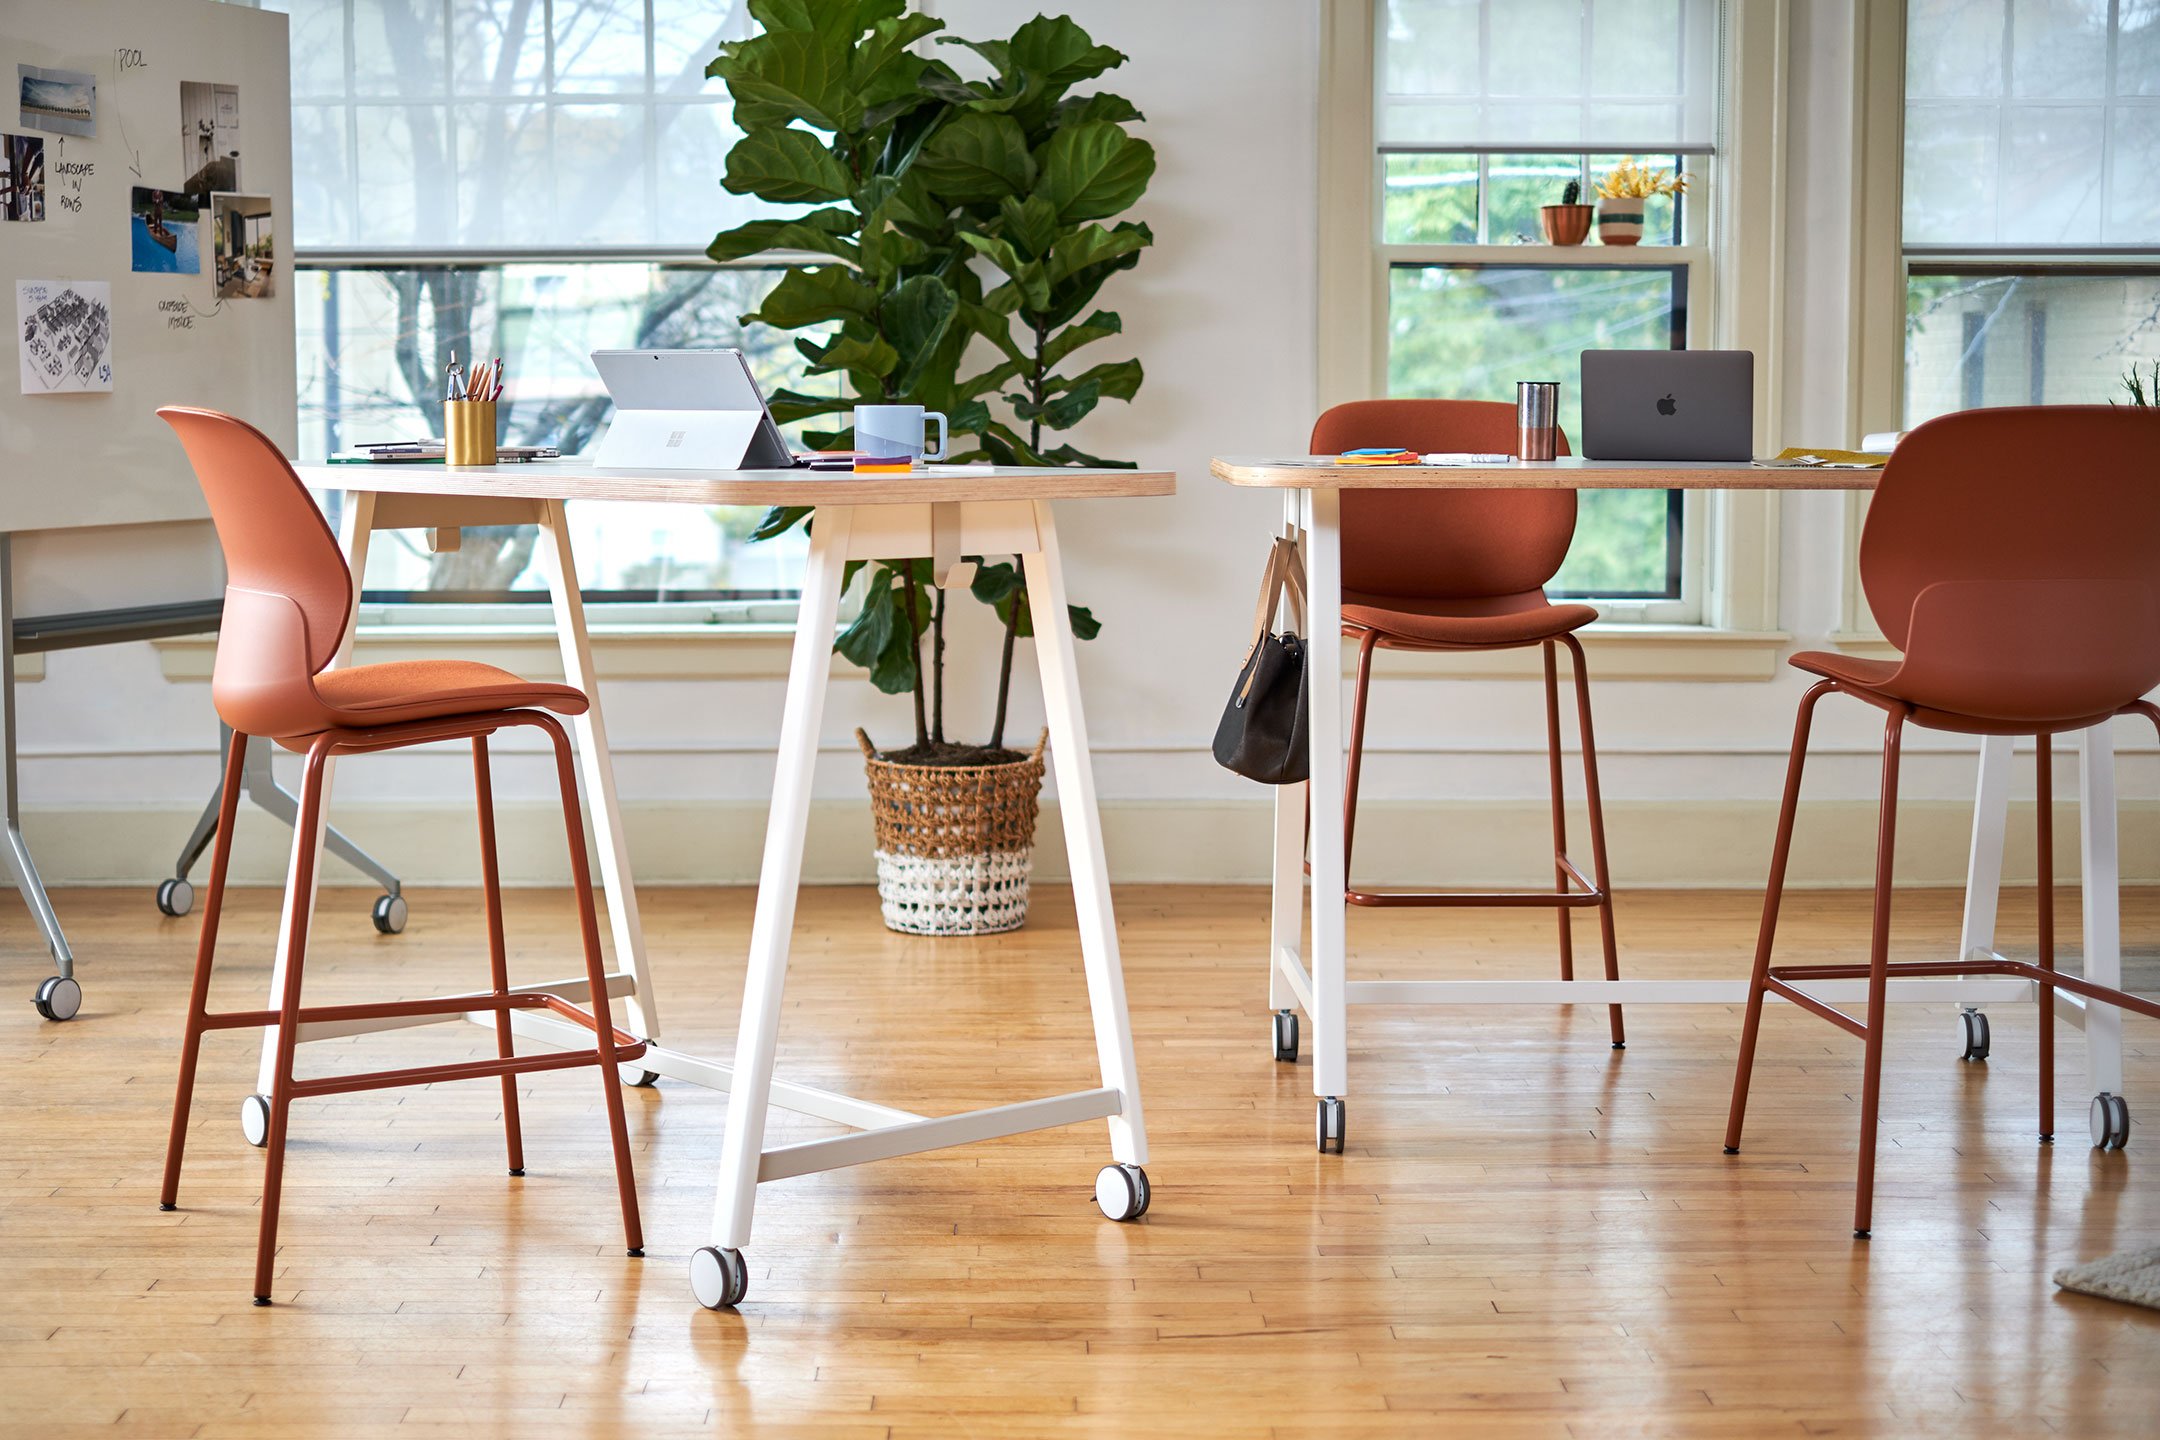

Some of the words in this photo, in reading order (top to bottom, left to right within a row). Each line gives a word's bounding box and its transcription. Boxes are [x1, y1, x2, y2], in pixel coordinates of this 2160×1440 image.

[118, 48, 148, 71] POOL
[54, 161, 95, 177] LANDSCAPE
[72, 178, 82, 192] IN
